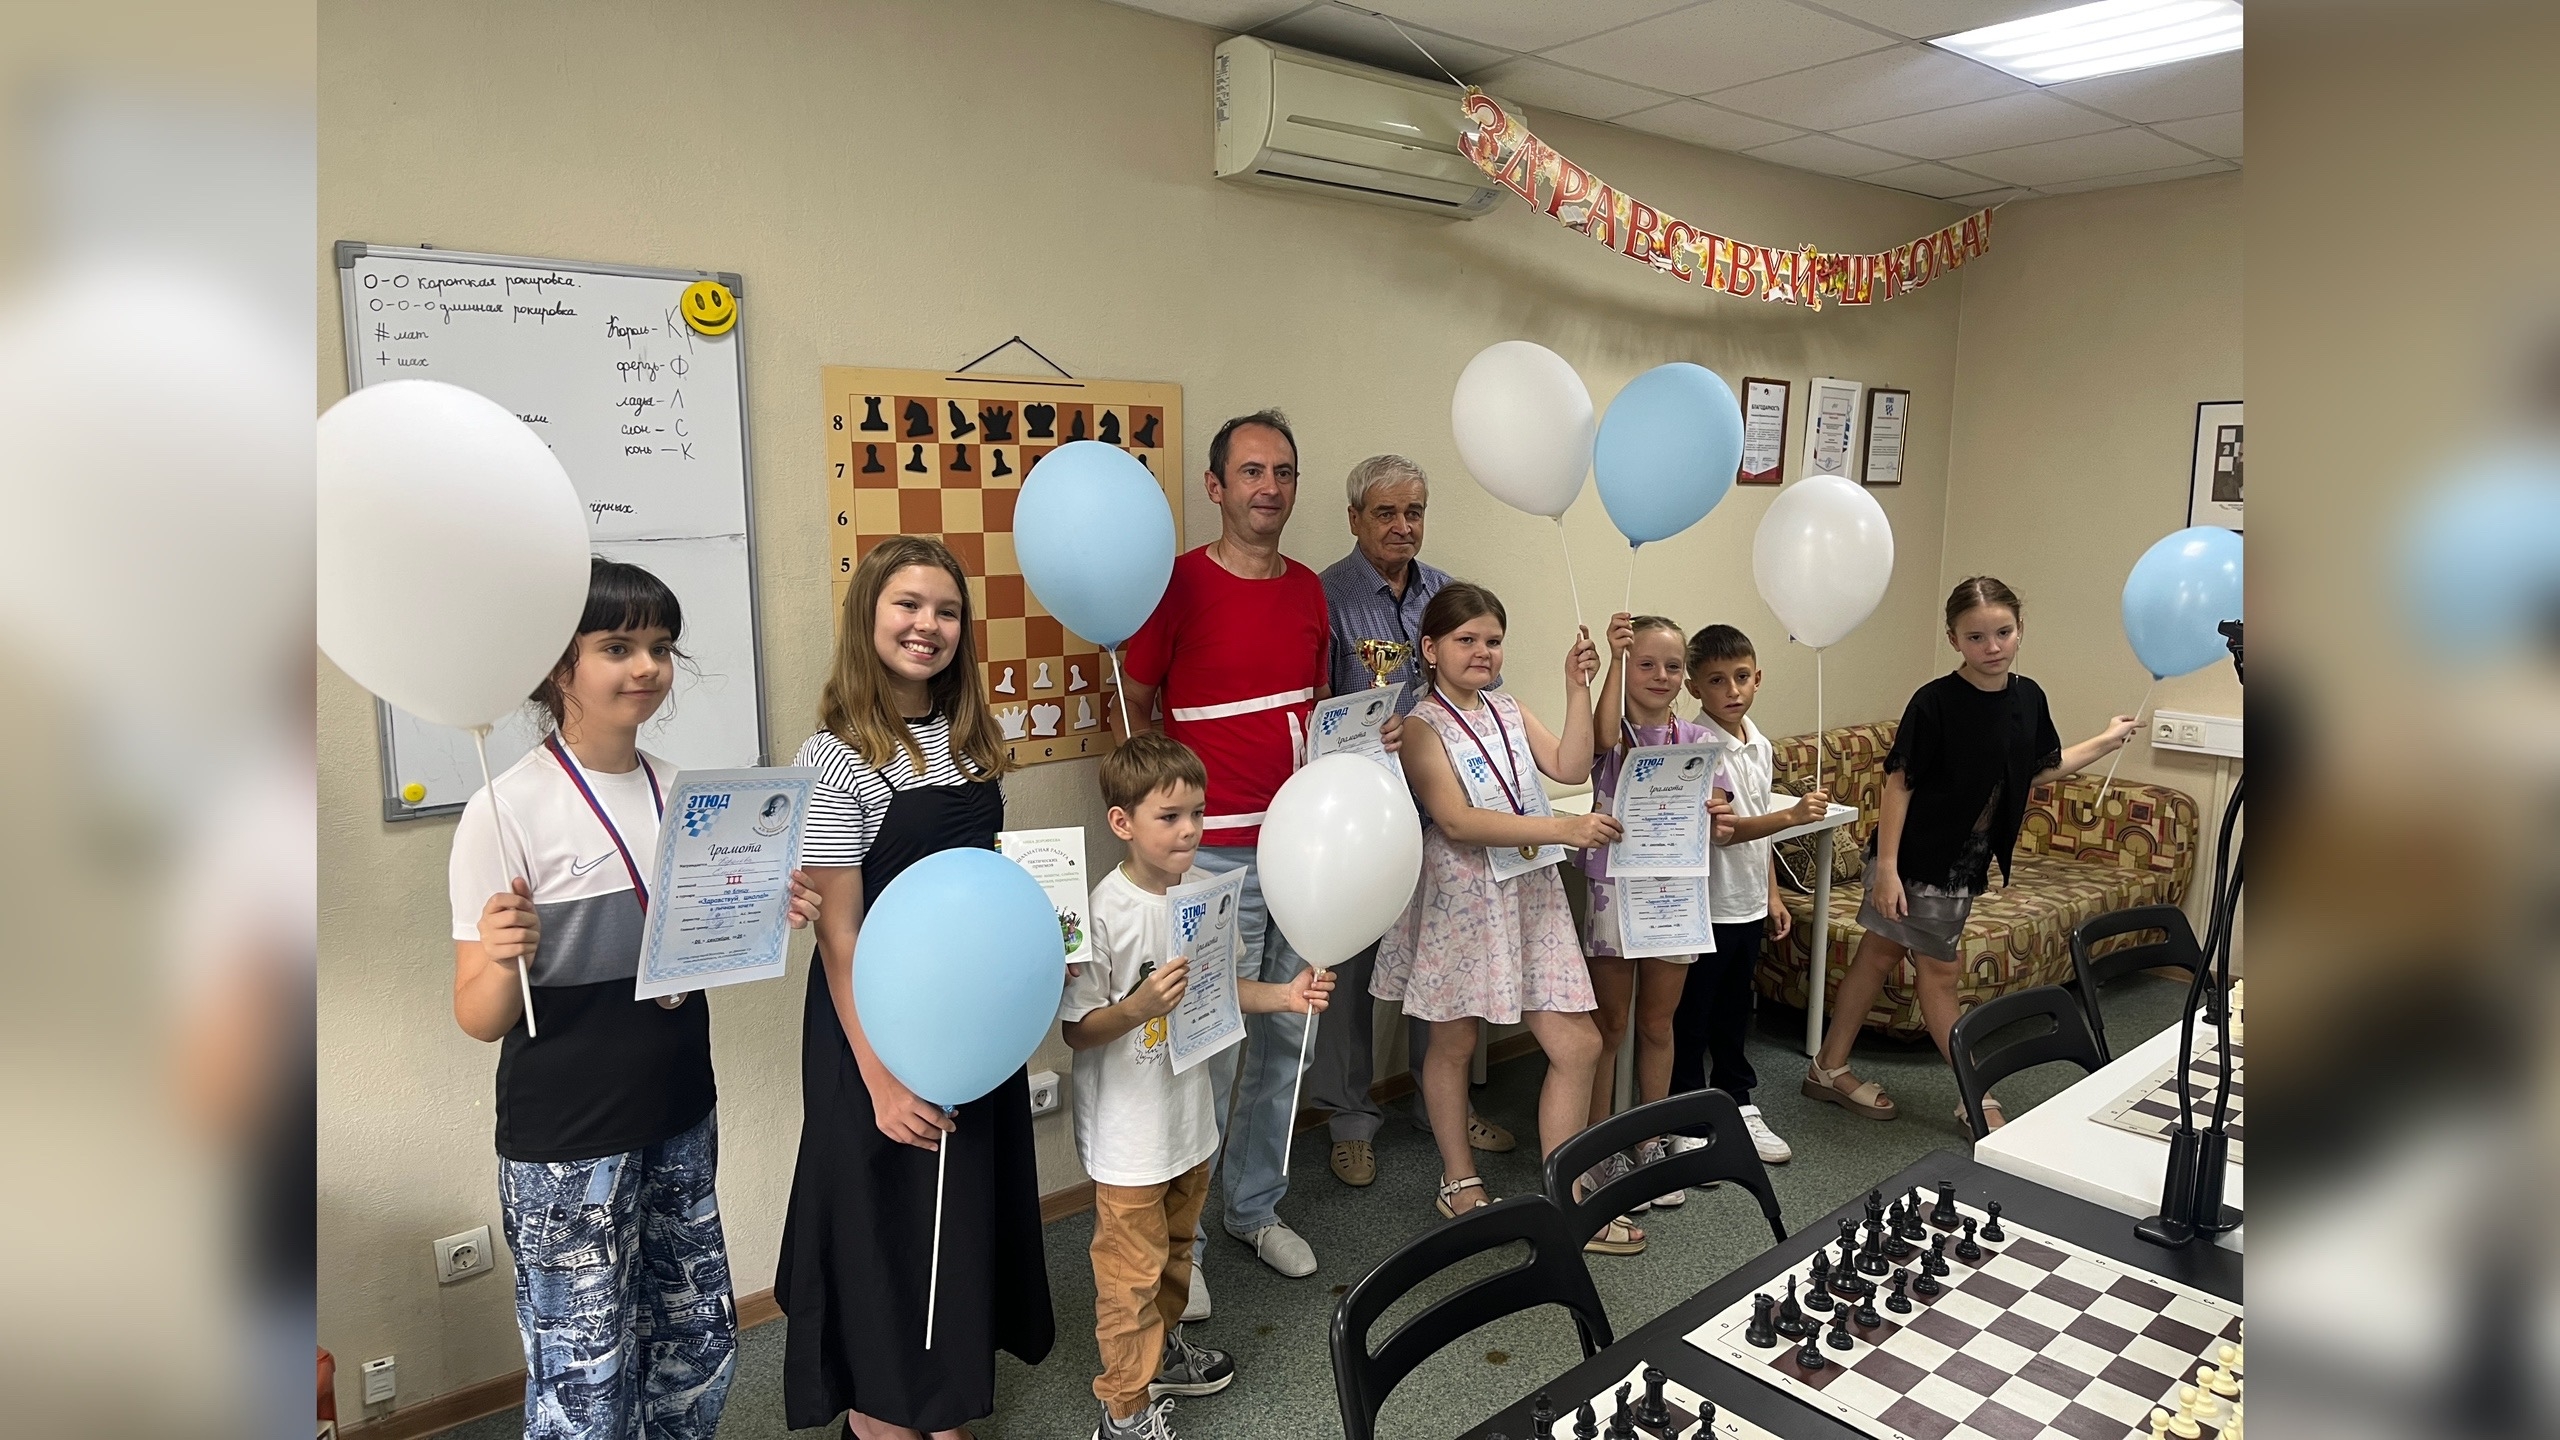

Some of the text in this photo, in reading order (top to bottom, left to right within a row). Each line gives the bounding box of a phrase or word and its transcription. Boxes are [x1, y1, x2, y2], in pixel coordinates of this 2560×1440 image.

[1457, 94, 1993, 308] ЗДРАВСТВУЙ ШКОЛА!
[833, 415, 843, 431] 8
[624, 446, 652, 456] конь
[835, 463, 845, 478] 7
[837, 511, 848, 525] 6
[840, 558, 850, 572] 5
[1324, 707, 1349, 720] ЭТЮД
[1045, 747, 1053, 757] e
[1081, 738, 1088, 752] f
[1636, 758, 1665, 767] ЭТЮД
[687, 794, 731, 809] ЭТЮД
[707, 842, 762, 861] Грамота
[726, 875, 742, 885] III
[1182, 903, 1206, 920] ЭТЮД
[1726, 1424, 1738, 1433] 2
